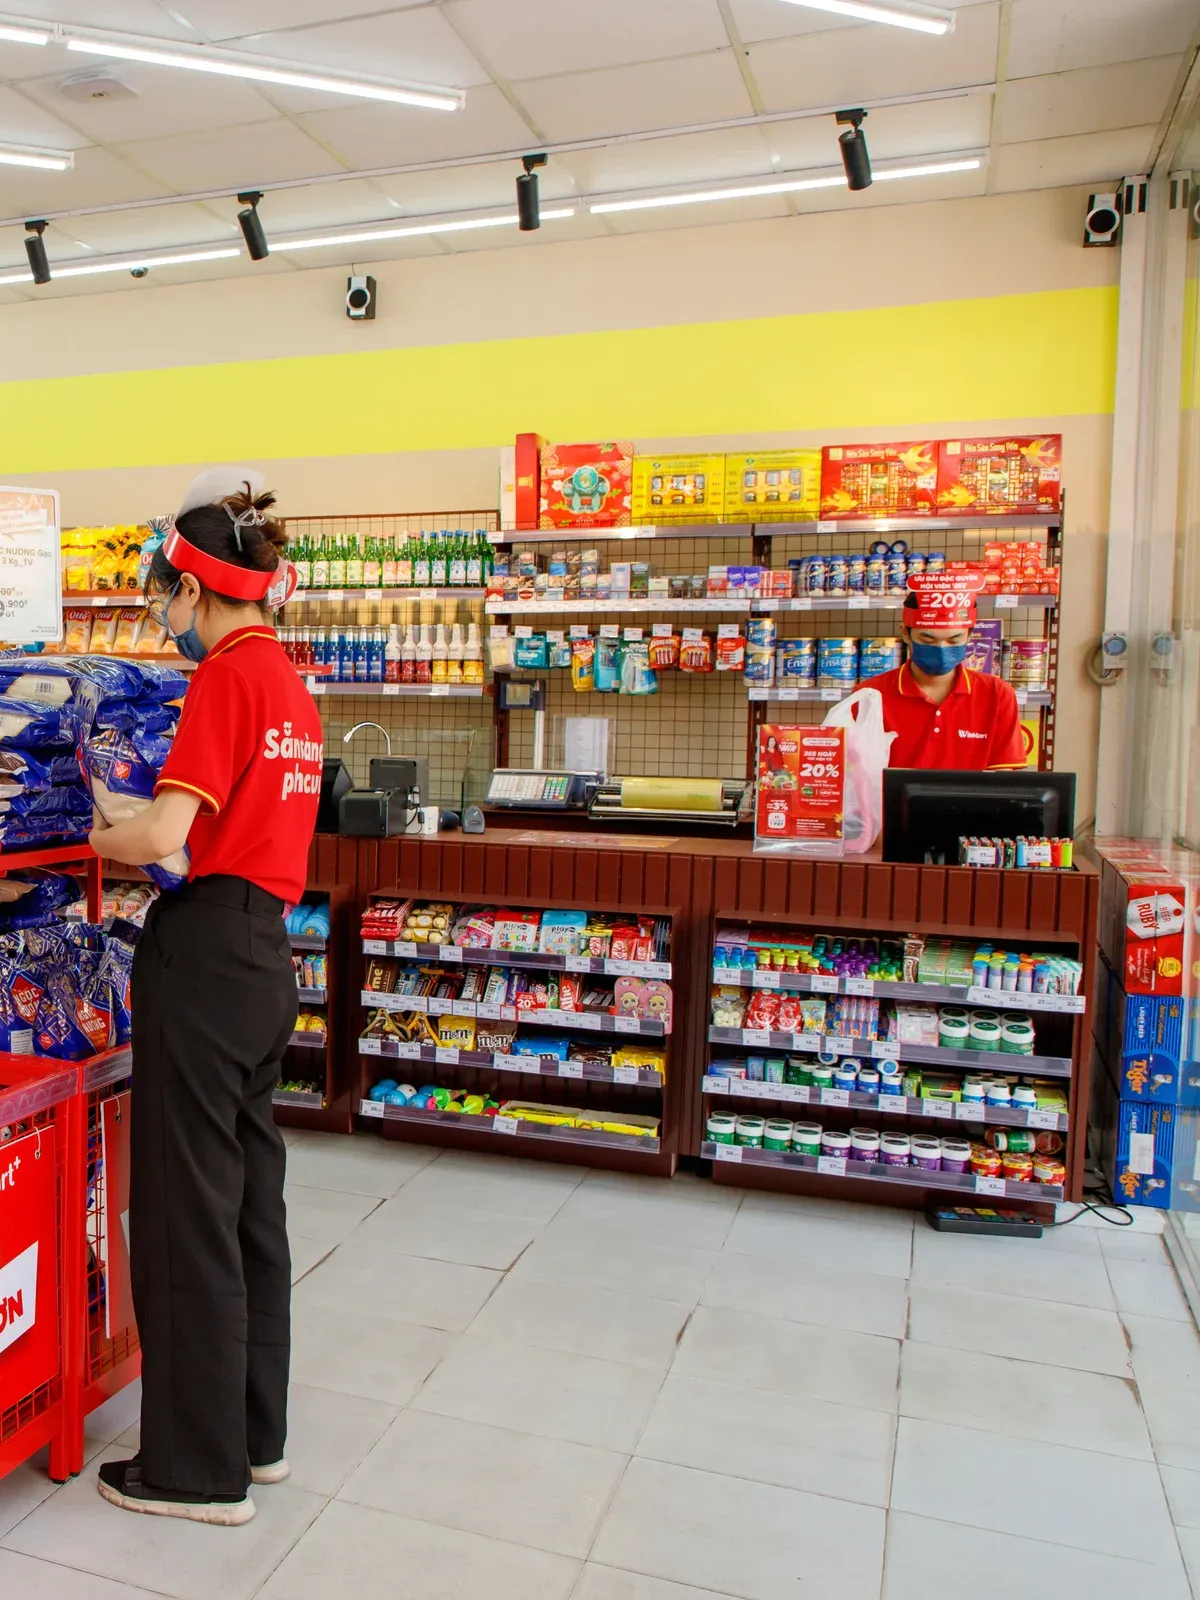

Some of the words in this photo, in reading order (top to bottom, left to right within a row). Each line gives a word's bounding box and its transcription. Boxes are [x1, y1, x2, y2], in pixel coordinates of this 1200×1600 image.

[930, 592, 971, 608] 20%
[861, 656, 882, 667] sure
[800, 764, 839, 778] 20%
[1137, 903, 1160, 929] RUBY
[1159, 906, 1171, 923] BEER
[1126, 1060, 1148, 1095] Tiger
